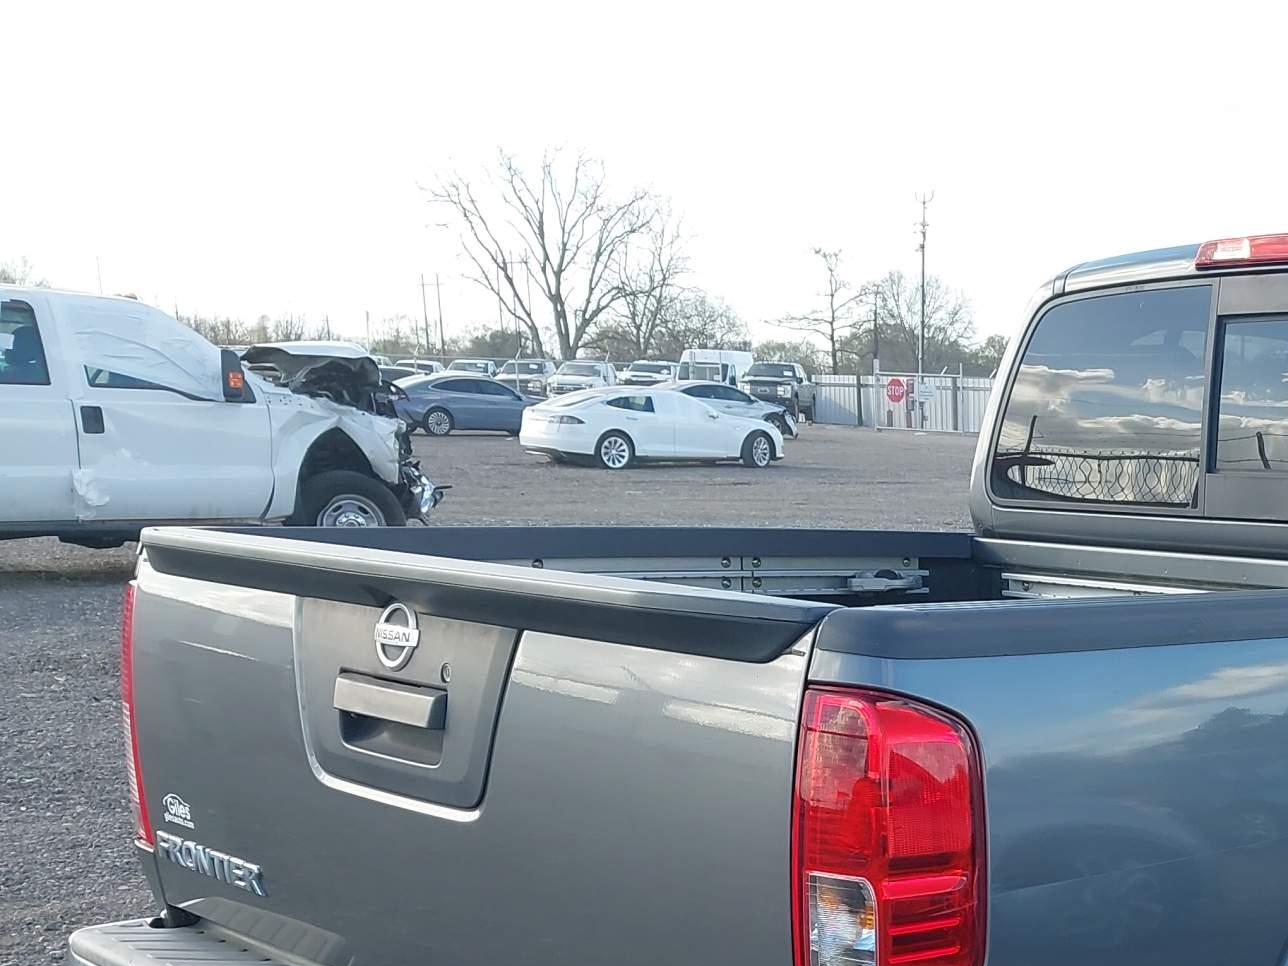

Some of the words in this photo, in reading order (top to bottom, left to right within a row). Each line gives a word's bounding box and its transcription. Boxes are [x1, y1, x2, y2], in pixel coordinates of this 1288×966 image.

[887, 385, 904, 396] STOP
[375, 627, 411, 642] NISSAN
[156, 830, 267, 897] FRONTIER
